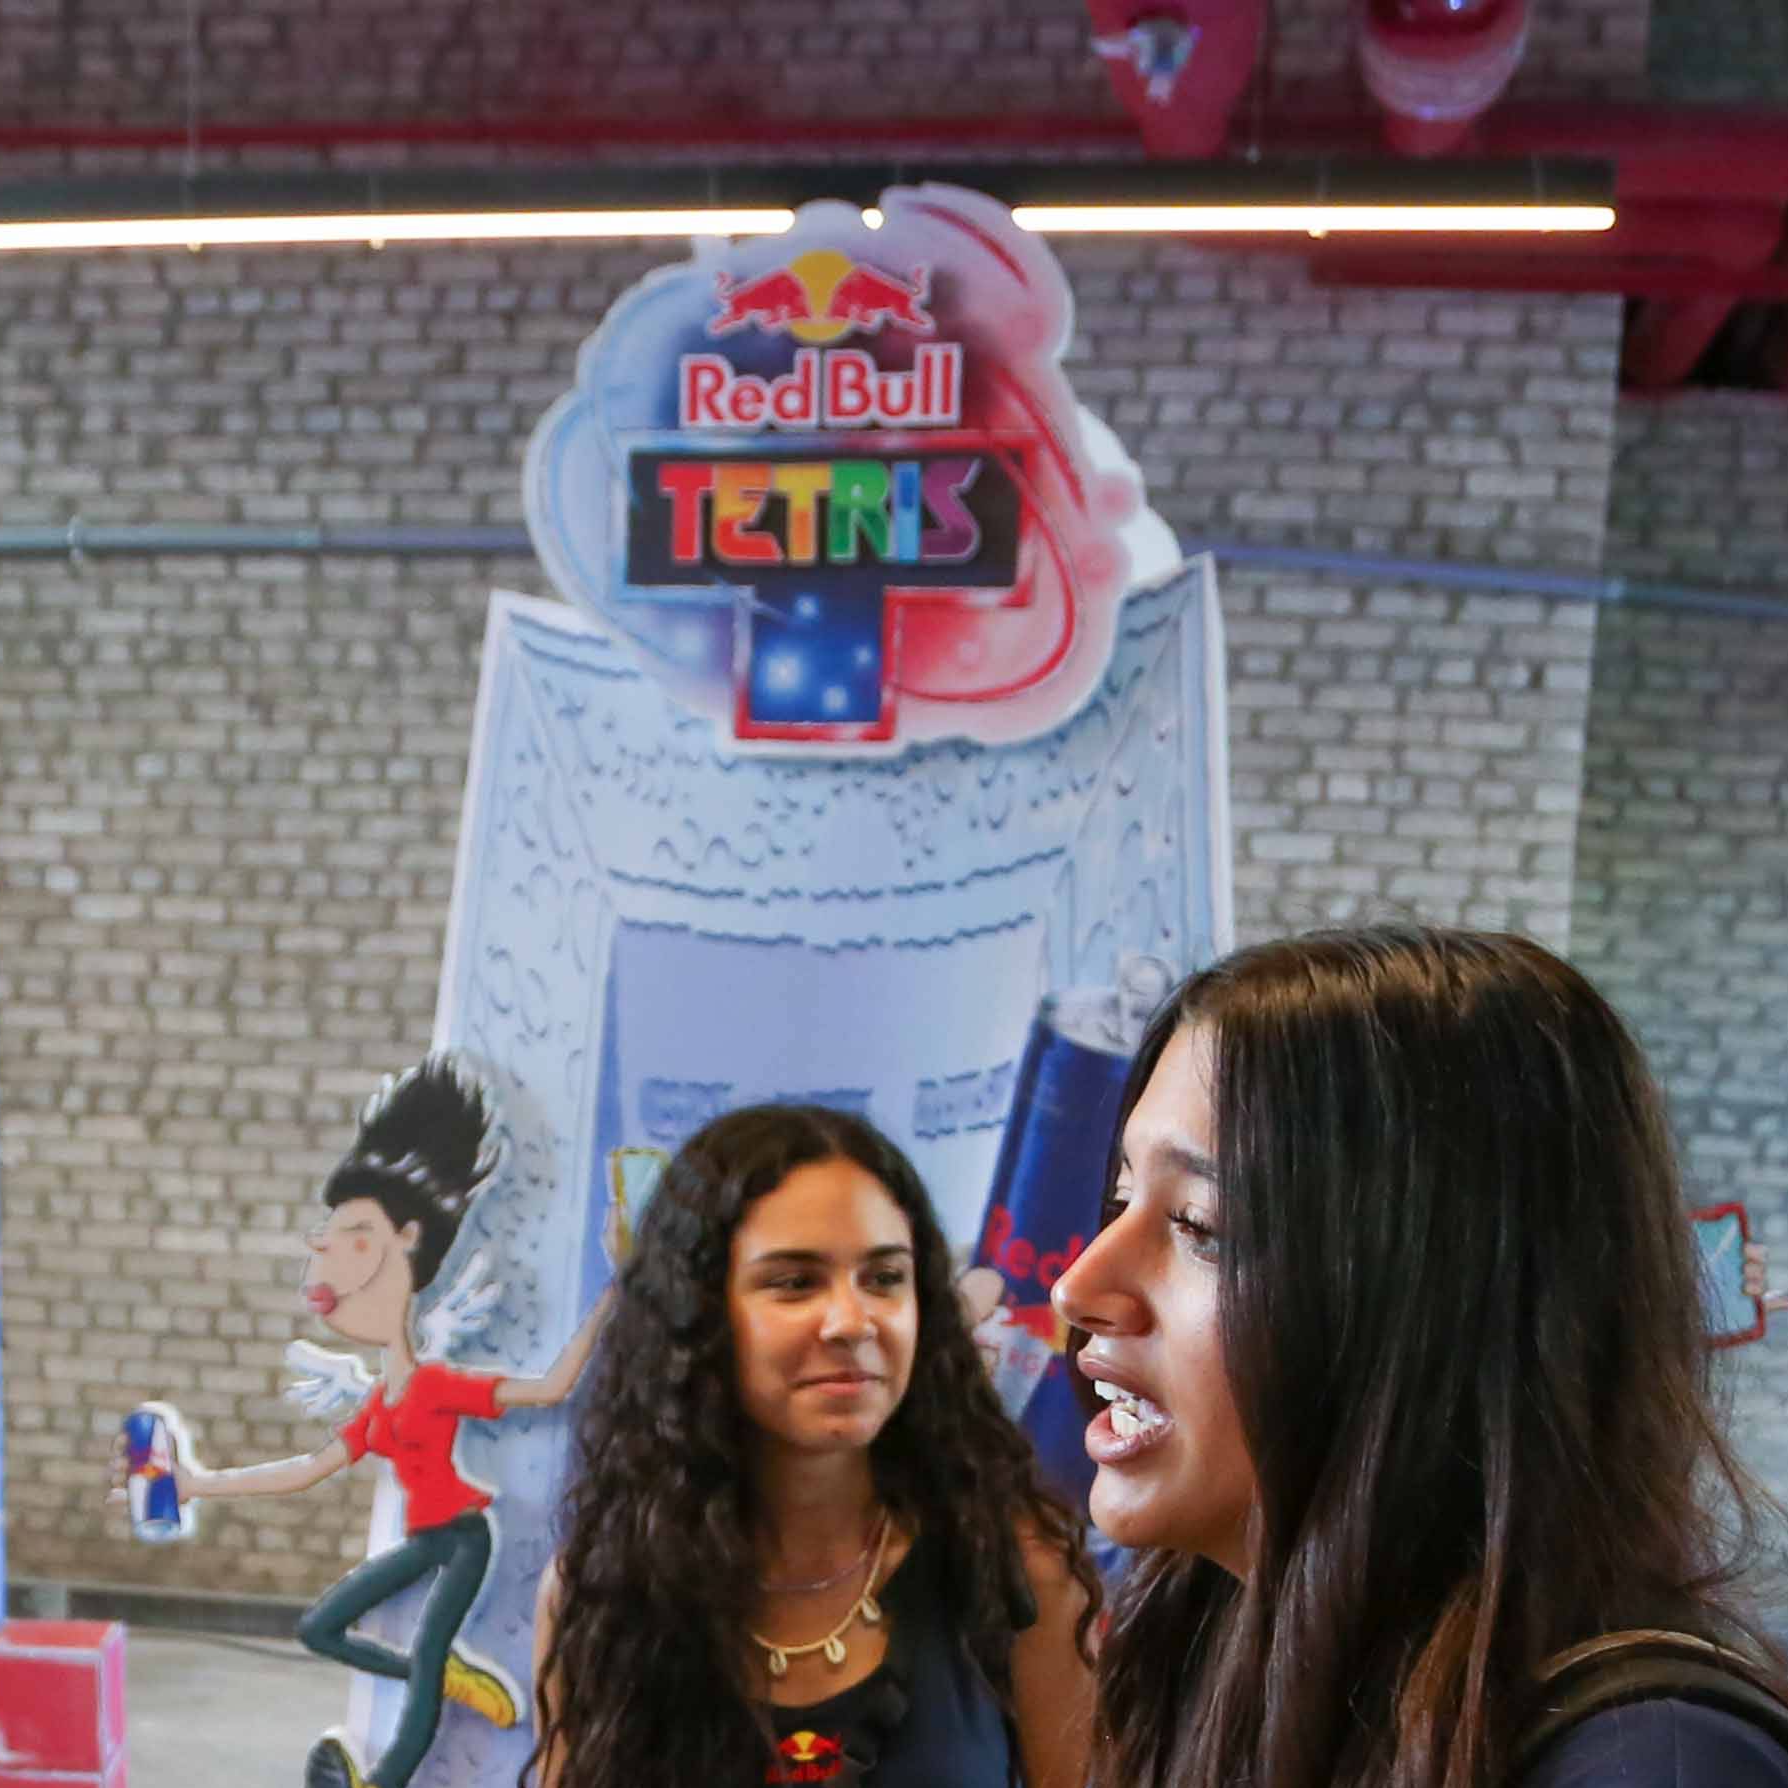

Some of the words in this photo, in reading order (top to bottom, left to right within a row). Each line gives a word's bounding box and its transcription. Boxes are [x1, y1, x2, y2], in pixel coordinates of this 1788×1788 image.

[684, 354, 815, 425] Red
[826, 350, 956, 420] Bull
[658, 458, 984, 566] TETRIS
